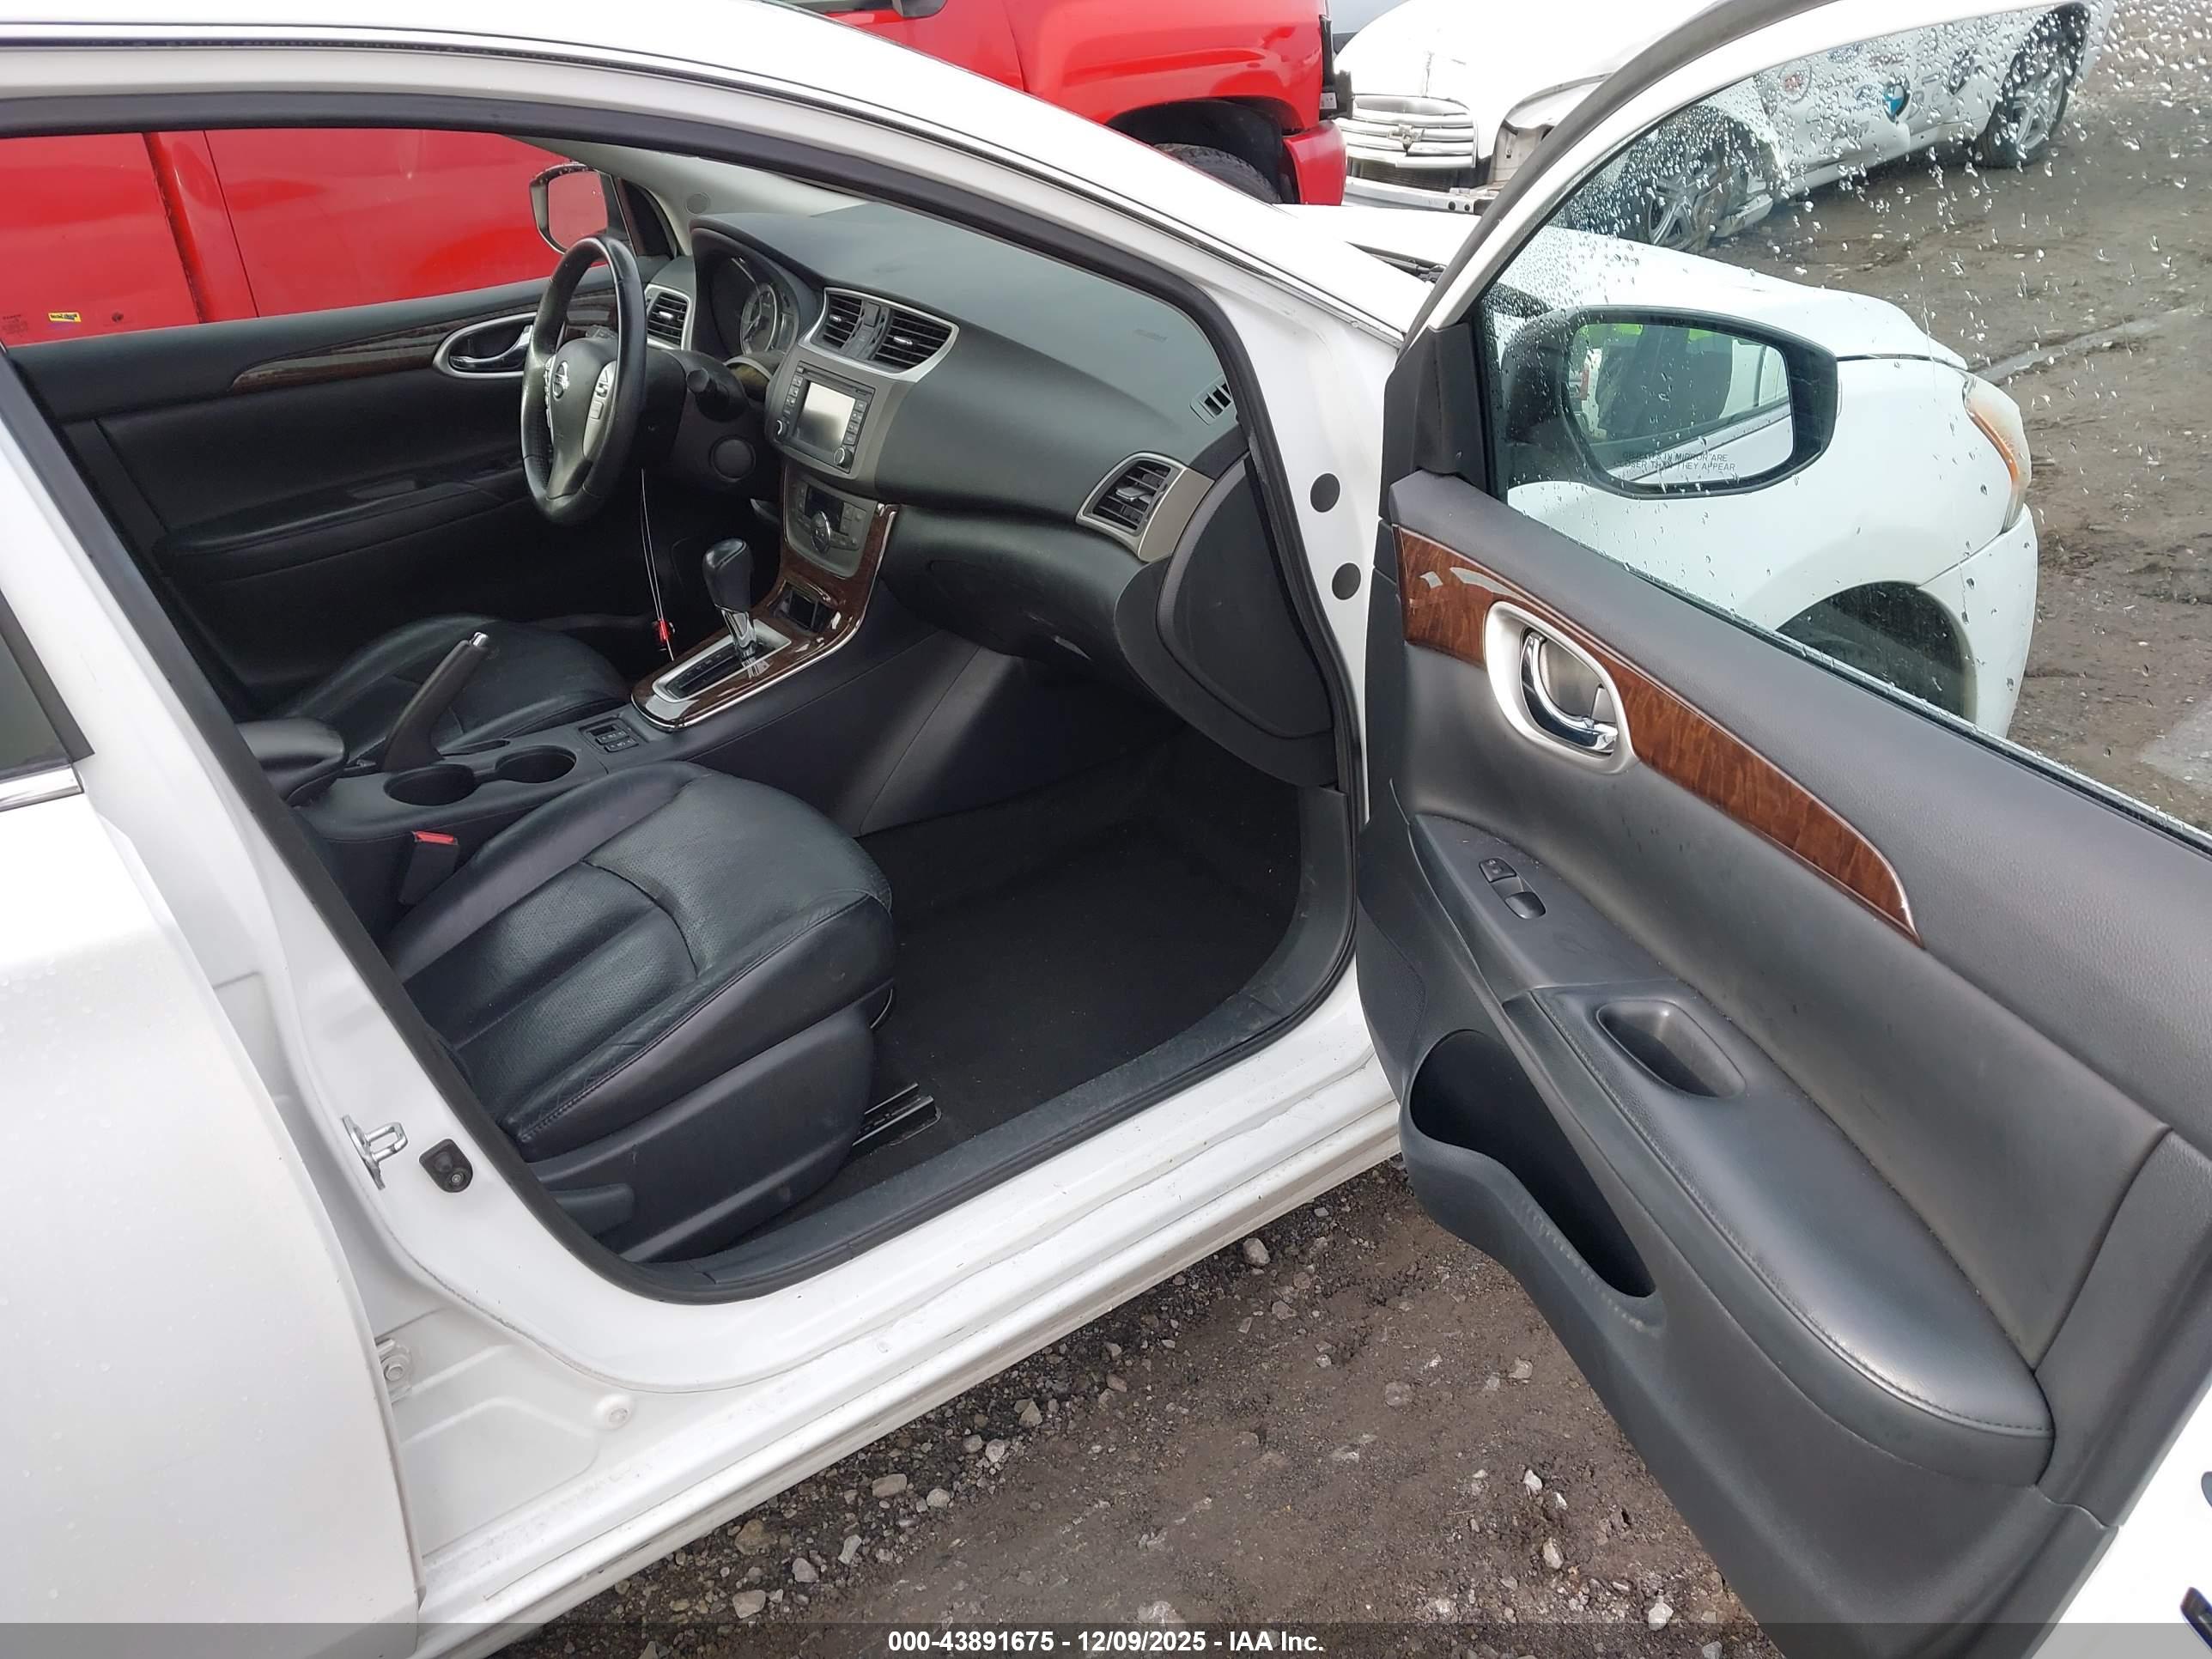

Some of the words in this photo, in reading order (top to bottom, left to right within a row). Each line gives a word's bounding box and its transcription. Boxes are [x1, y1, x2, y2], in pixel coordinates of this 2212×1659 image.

[1622, 452, 1662, 461] OBJECTS
[1664, 452, 1673, 461] IN
[1674, 453, 1708, 461] MIRROR
[1709, 453, 1728, 462] ARE
[1651, 460, 1674, 469] THAN
